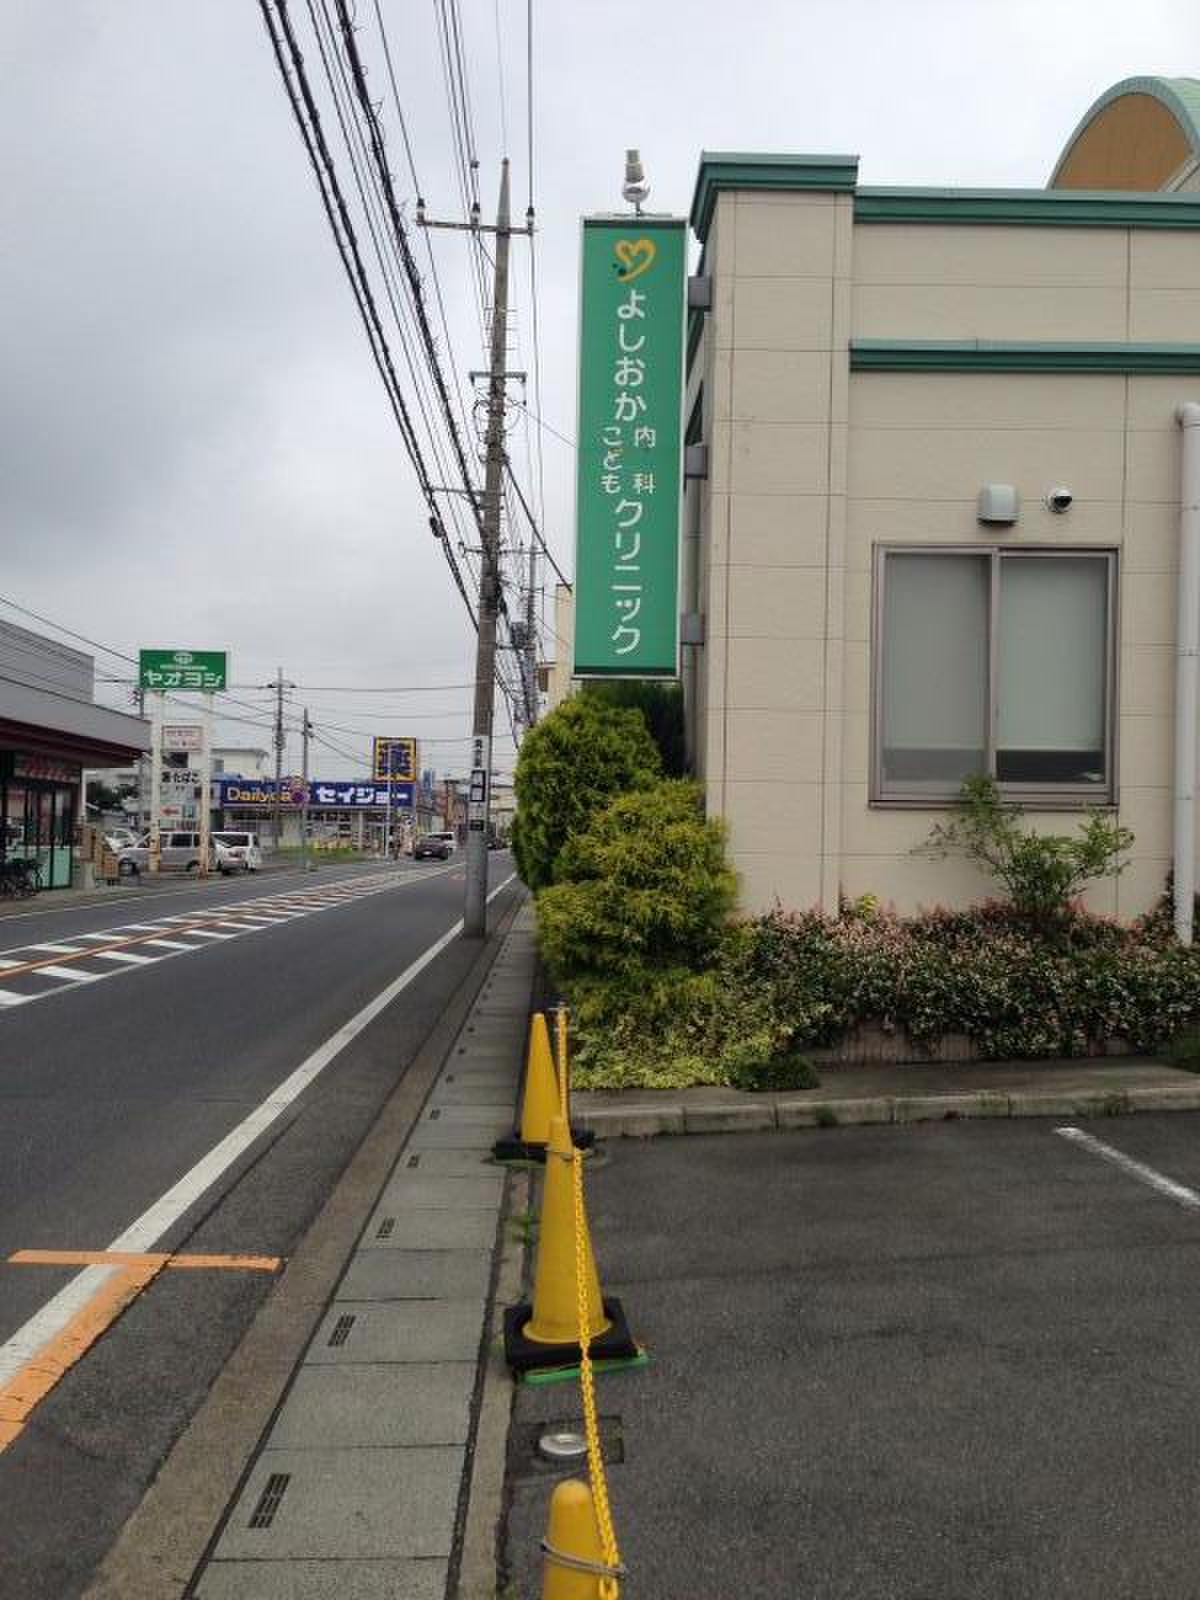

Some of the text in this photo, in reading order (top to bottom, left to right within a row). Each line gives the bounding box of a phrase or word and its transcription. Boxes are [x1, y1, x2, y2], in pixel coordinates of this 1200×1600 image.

[614, 289, 647, 422] よしおか
[601, 427, 623, 494] こども
[634, 427, 656, 494] 内科
[611, 499, 642, 655] クリニック
[143, 669, 223, 687] ヤオヨシ
[316, 786, 409, 804] セイジョー
